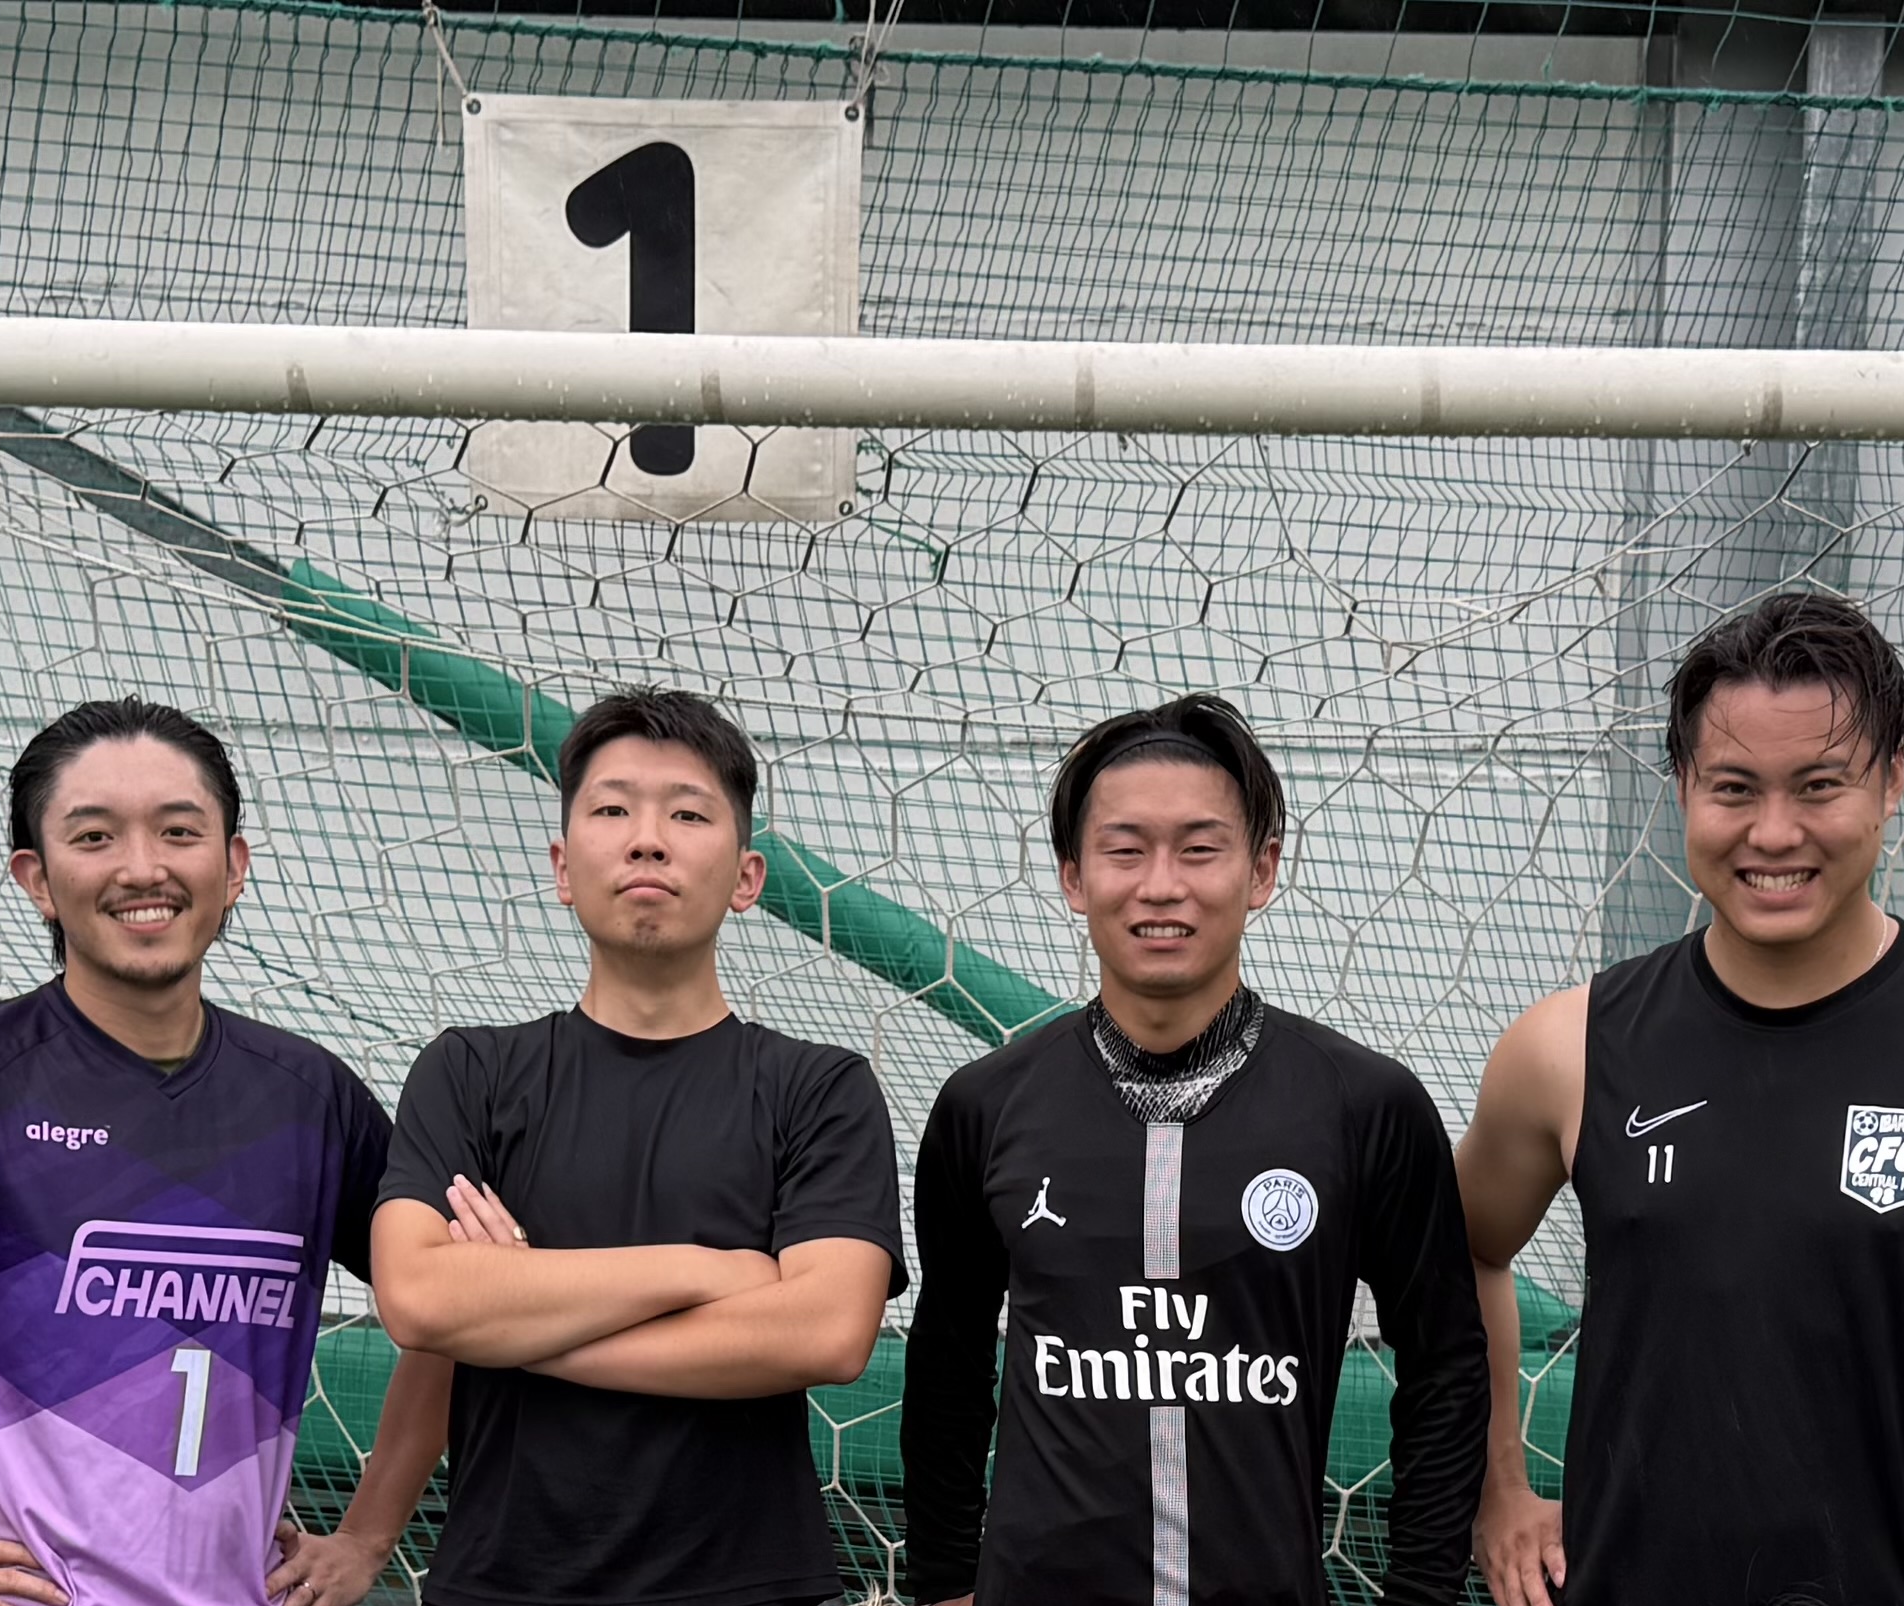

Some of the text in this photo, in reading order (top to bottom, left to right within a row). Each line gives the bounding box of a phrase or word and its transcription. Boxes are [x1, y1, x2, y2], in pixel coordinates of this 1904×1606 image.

[565, 141, 695, 476] 1
[26, 1121, 109, 1150] alegre
[1647, 1144, 1674, 1184] 11
[1851, 1172, 1899, 1190] CENTRAL
[1263, 1179, 1305, 1199] PARIS
[1119, 1286, 1208, 1340] Fly
[1034, 1334, 1299, 1406] Emirates
[171, 1348, 212, 1477] 1
